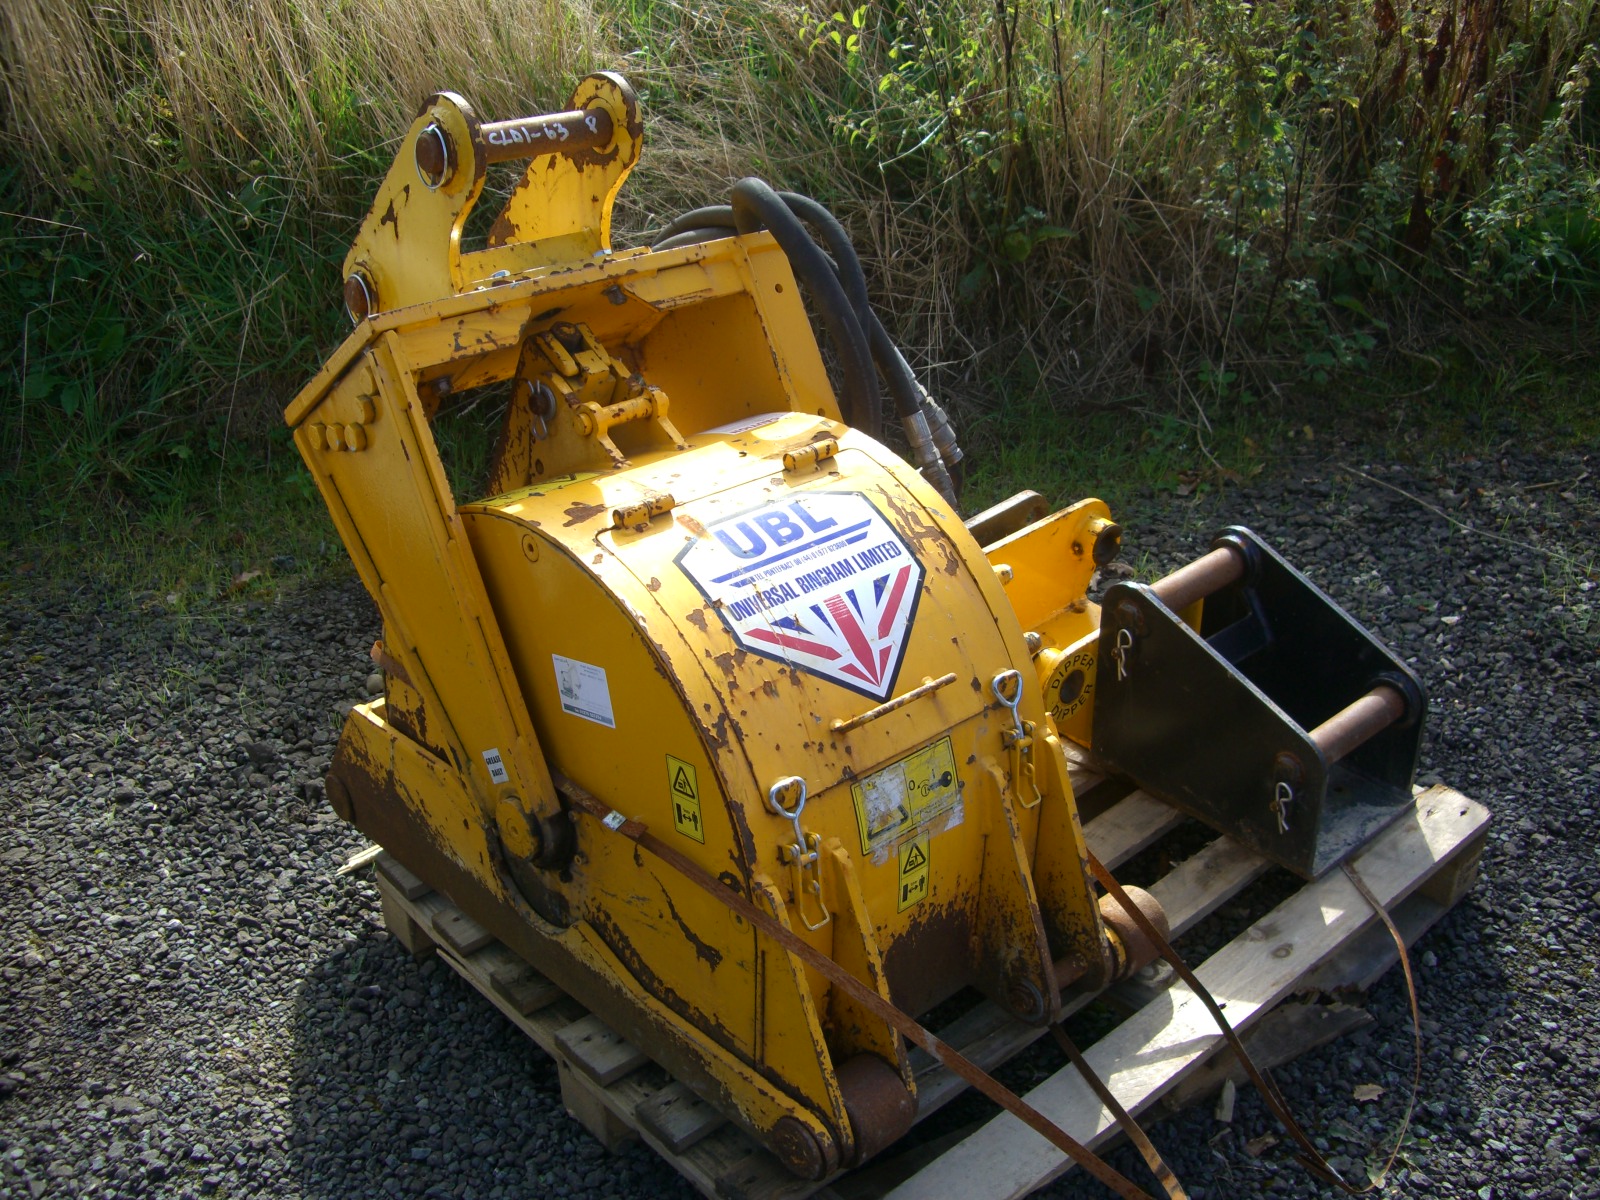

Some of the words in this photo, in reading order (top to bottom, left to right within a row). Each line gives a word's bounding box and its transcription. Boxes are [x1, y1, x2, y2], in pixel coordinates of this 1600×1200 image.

[712, 501, 839, 560] UBL
[728, 581, 801, 622] UNIVERSAL
[795, 556, 858, 595] BINGHAM
[852, 540, 903, 571] LIMITED
[1051, 653, 1095, 690] DIPPER
[1051, 684, 1094, 720] DIPPER
[485, 755, 502, 766] GREASE
[491, 768, 504, 777] DAILY
